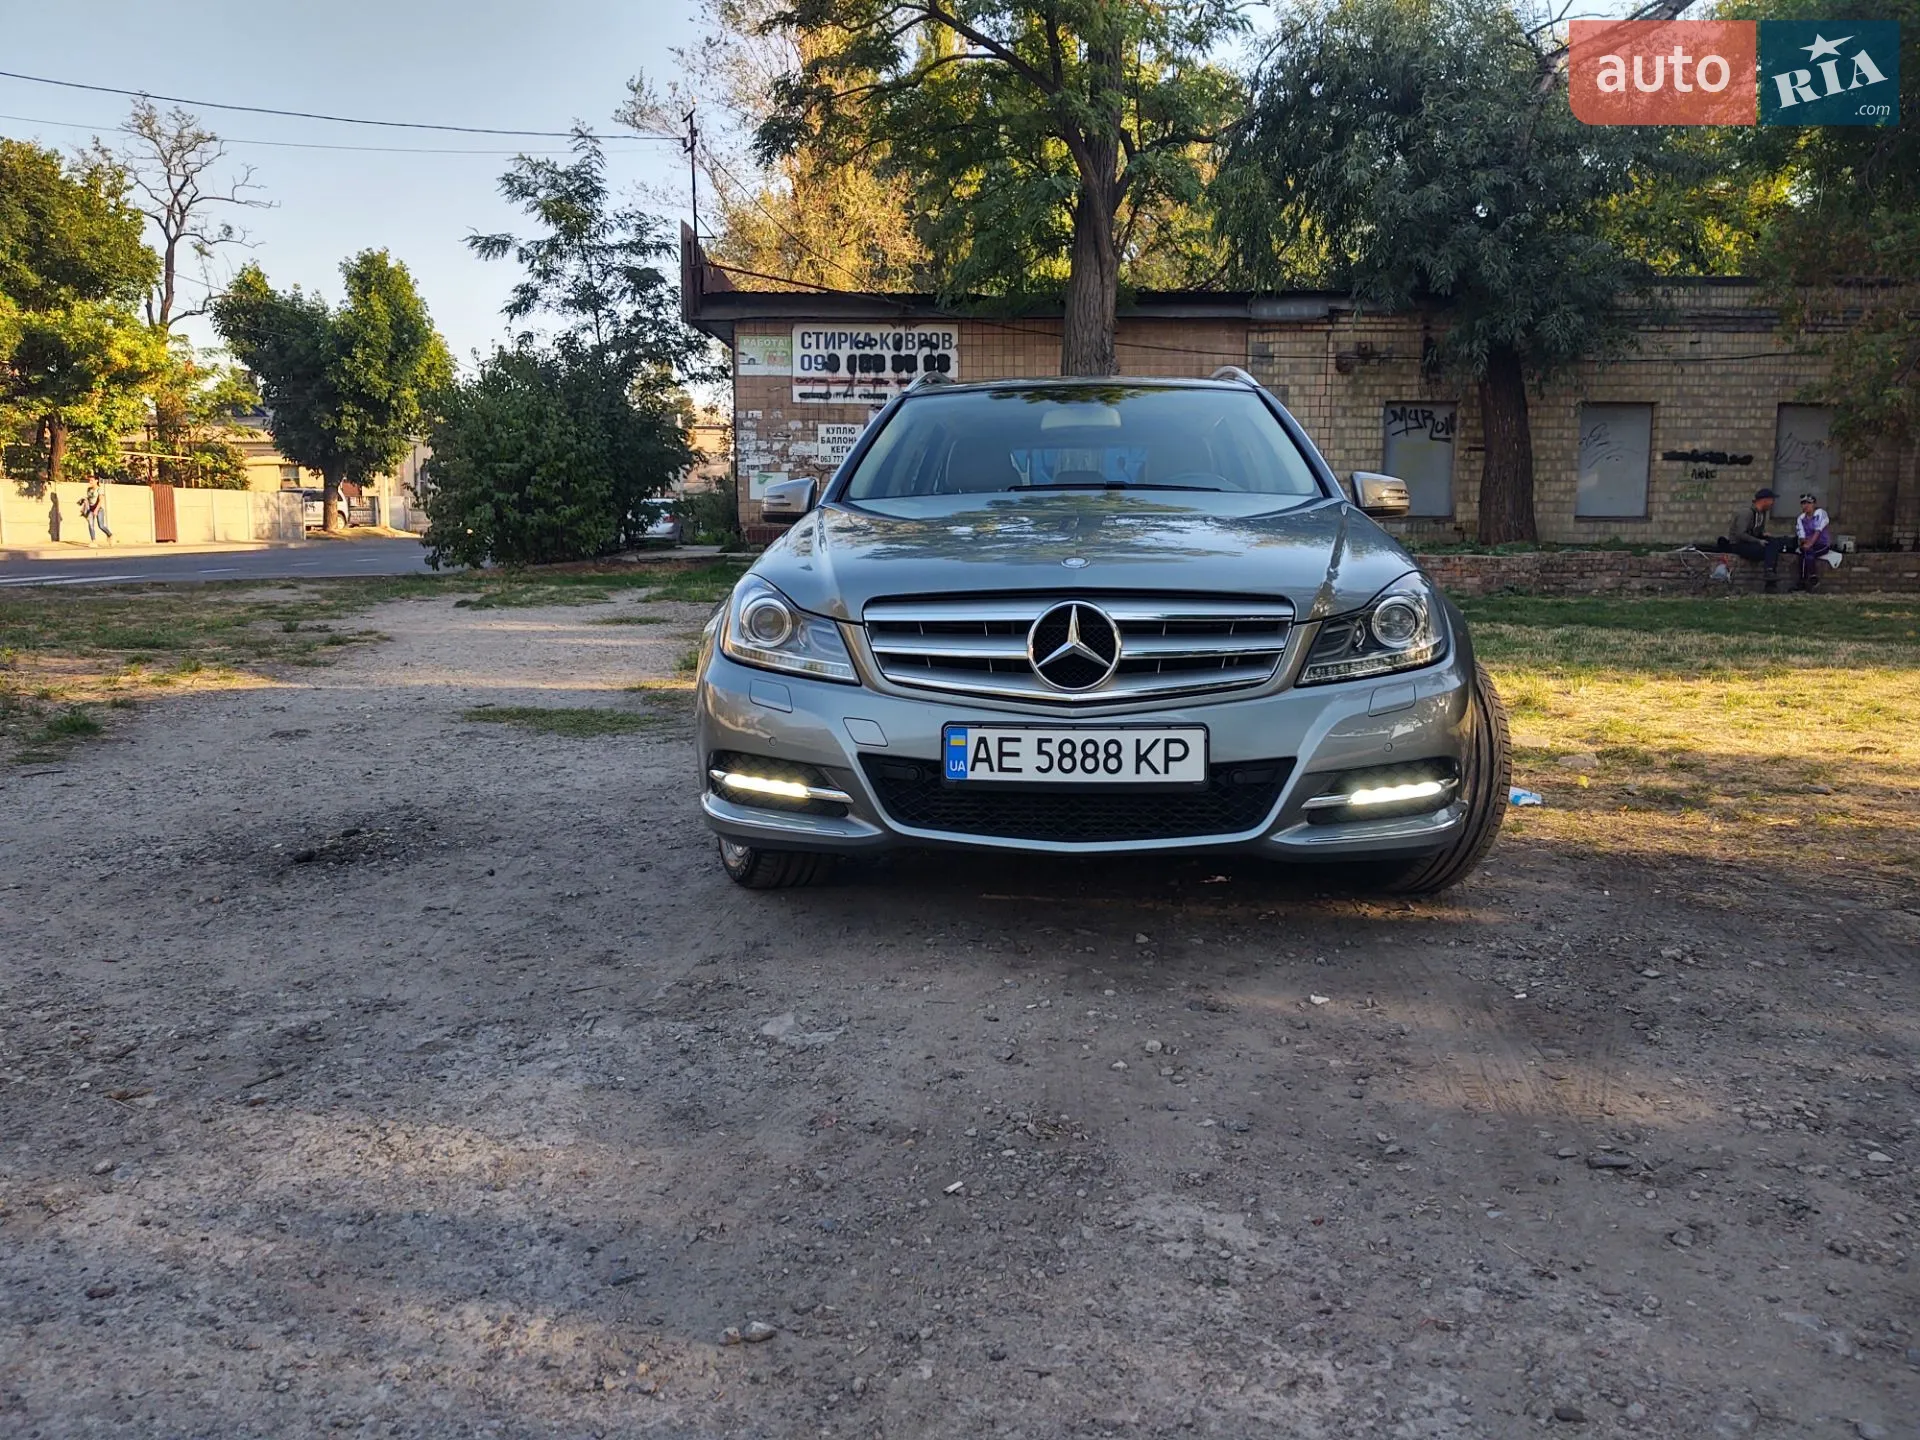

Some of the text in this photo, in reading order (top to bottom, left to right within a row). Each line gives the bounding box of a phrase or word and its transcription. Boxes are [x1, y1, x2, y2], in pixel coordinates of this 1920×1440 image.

[801, 332, 873, 350] СТИРКА
[826, 427, 856, 435] КУПЛЮ
[970, 736, 1190, 775] AE 5888 KP
[950, 761, 966, 772] UA
